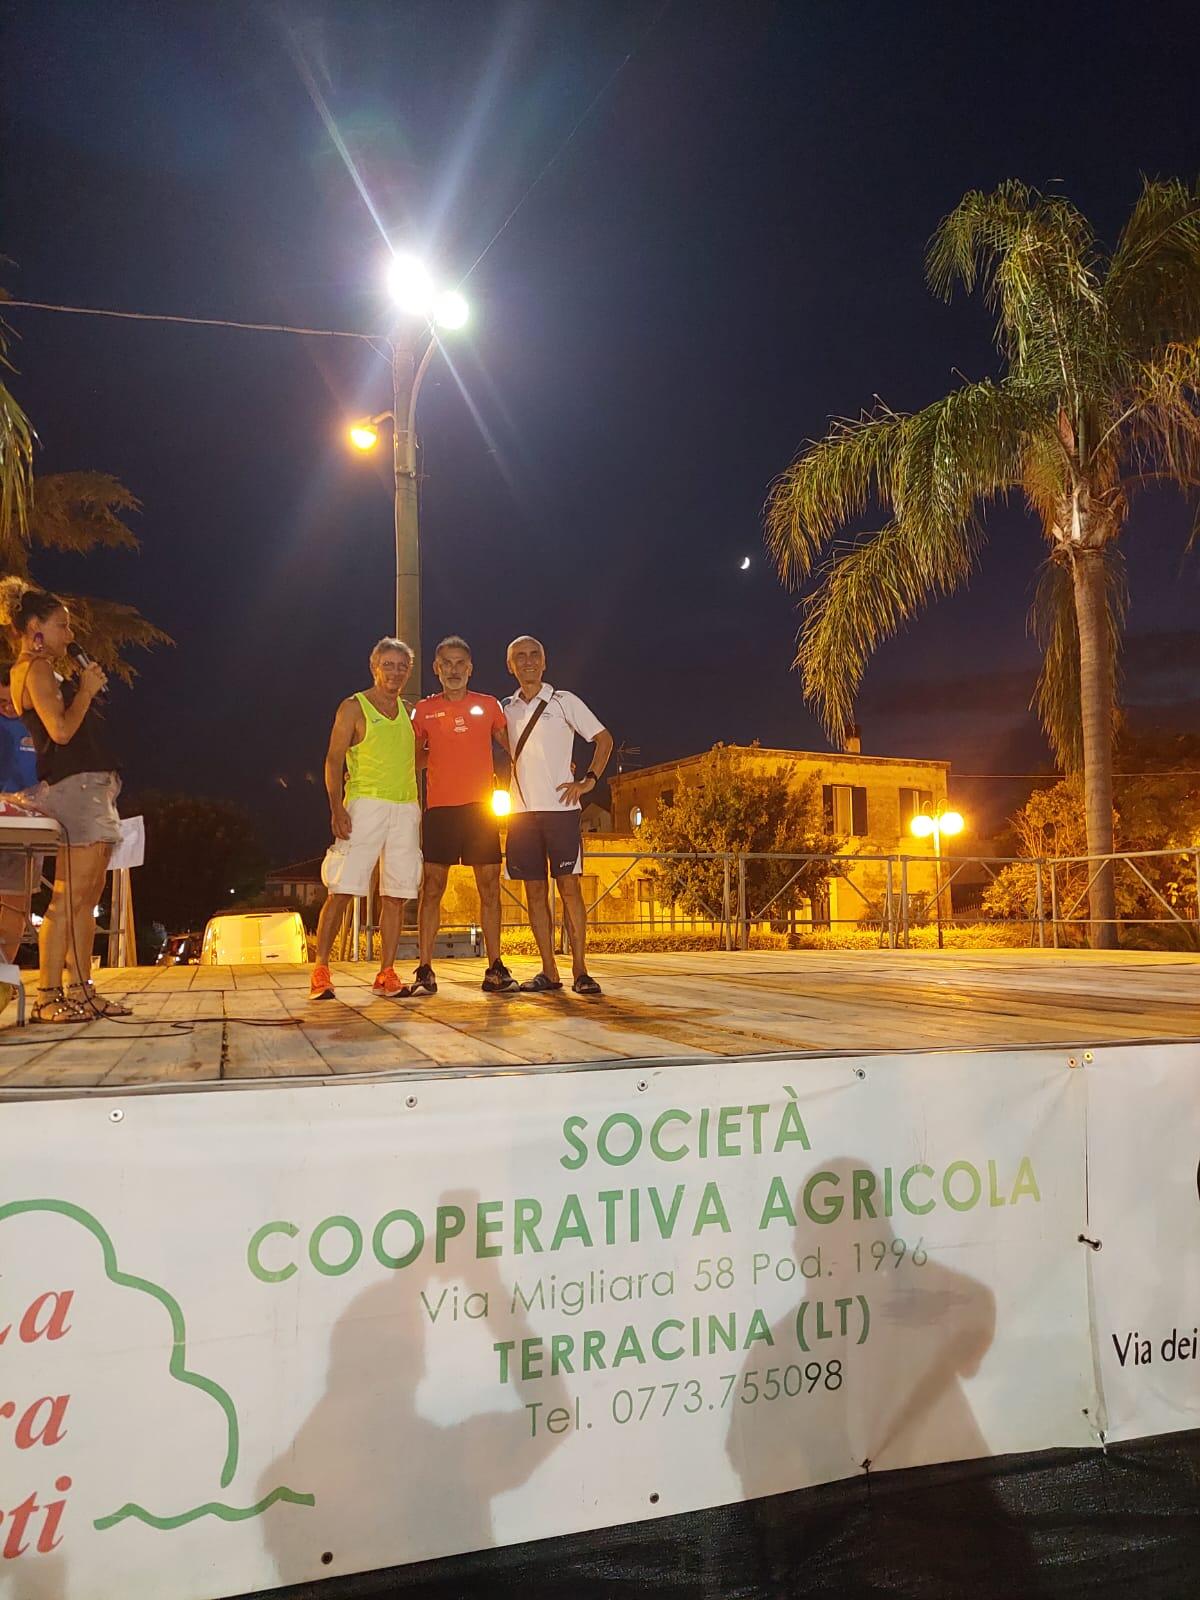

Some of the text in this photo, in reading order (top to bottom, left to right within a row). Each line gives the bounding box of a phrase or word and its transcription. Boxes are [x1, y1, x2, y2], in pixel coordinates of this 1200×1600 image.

[559, 1086, 811, 1170] SOCIETÀ
[247, 1156, 1041, 1284] COOPERATIVA AGRICOLA
[421, 1237, 928, 1323] Via Migliara 58 Pod. 1996
[493, 1295, 871, 1383] TERRACINA (LT)
[1112, 1328, 1198, 1367] Via dei
[525, 1360, 843, 1438] Tel. 0773.755098
